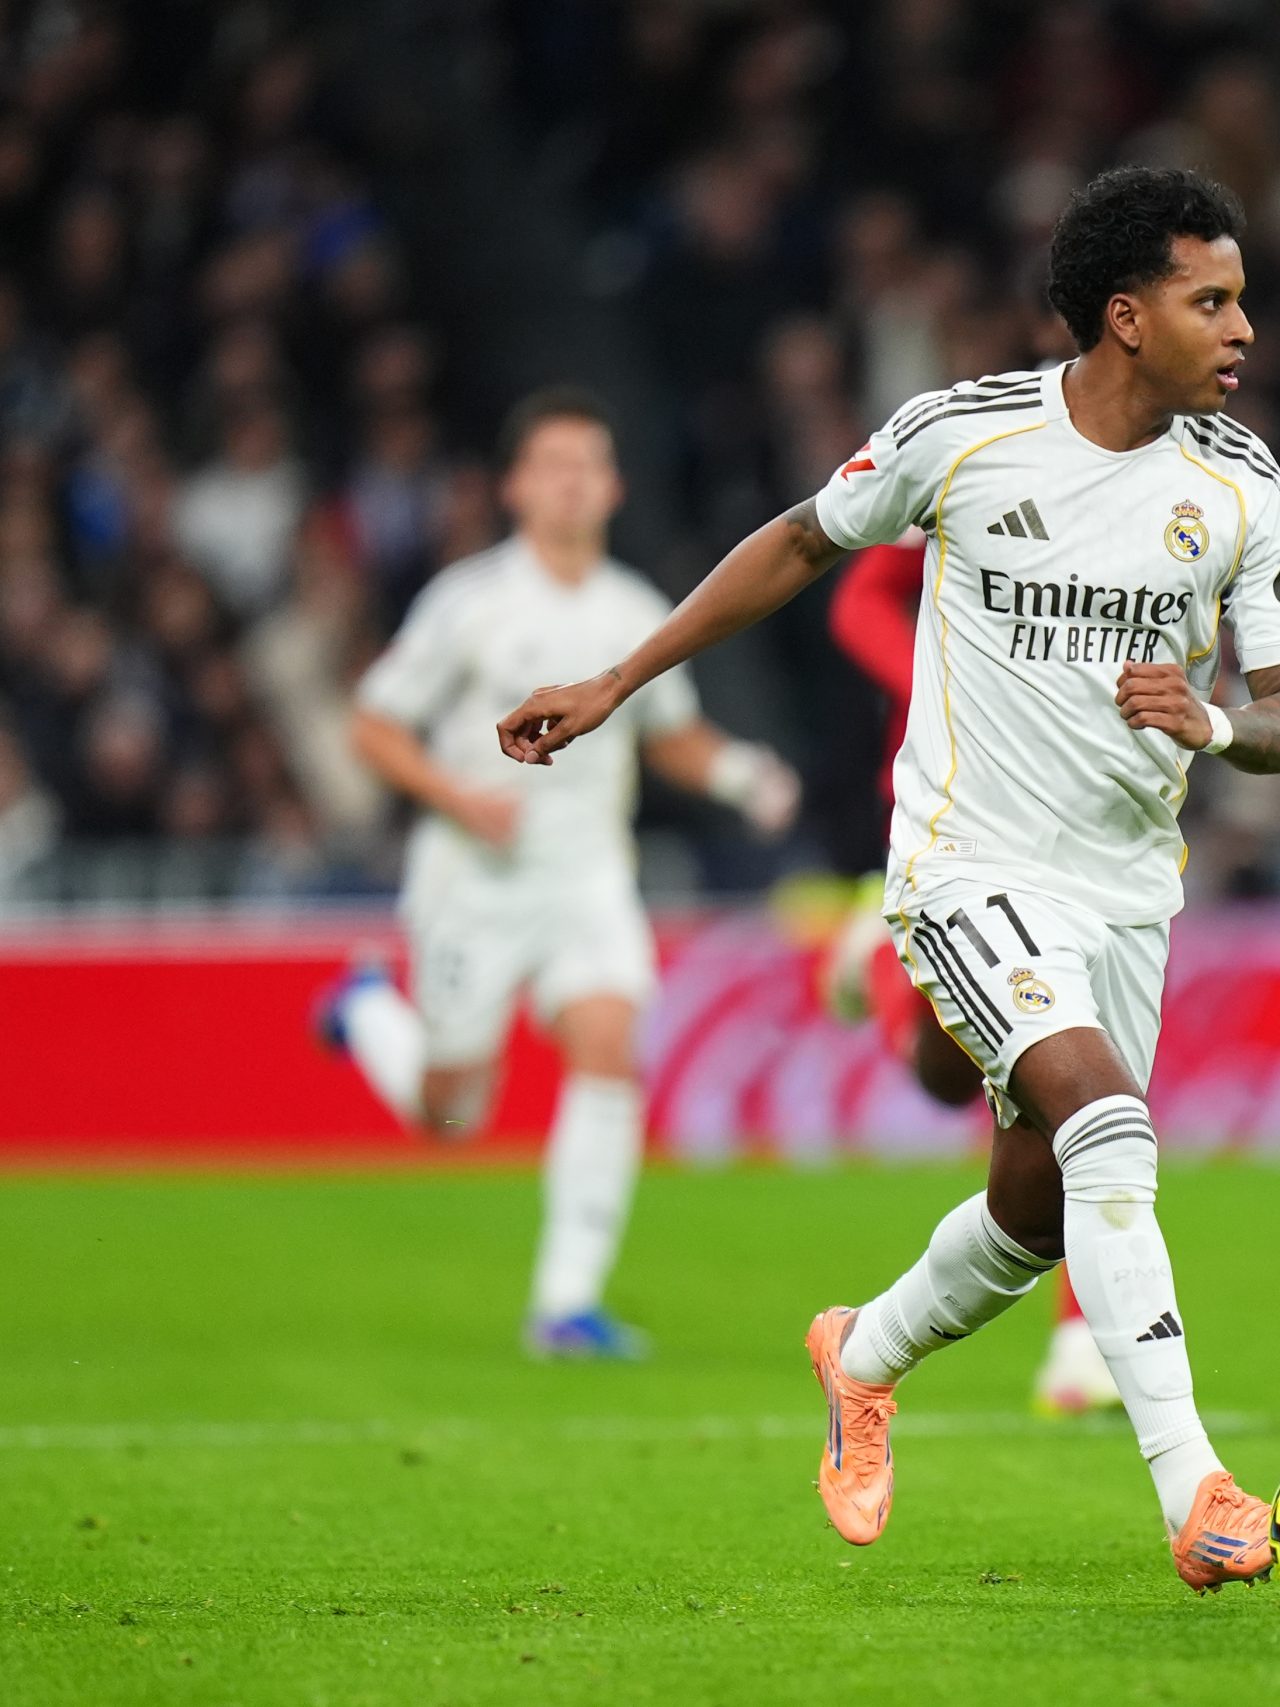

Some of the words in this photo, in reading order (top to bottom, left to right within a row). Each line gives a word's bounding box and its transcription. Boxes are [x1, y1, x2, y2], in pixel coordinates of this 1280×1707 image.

[979, 568, 1193, 626] Emirates
[1010, 624, 1056, 661] FLY
[1066, 626, 1161, 663] BETTER
[946, 893, 1041, 968] 11
